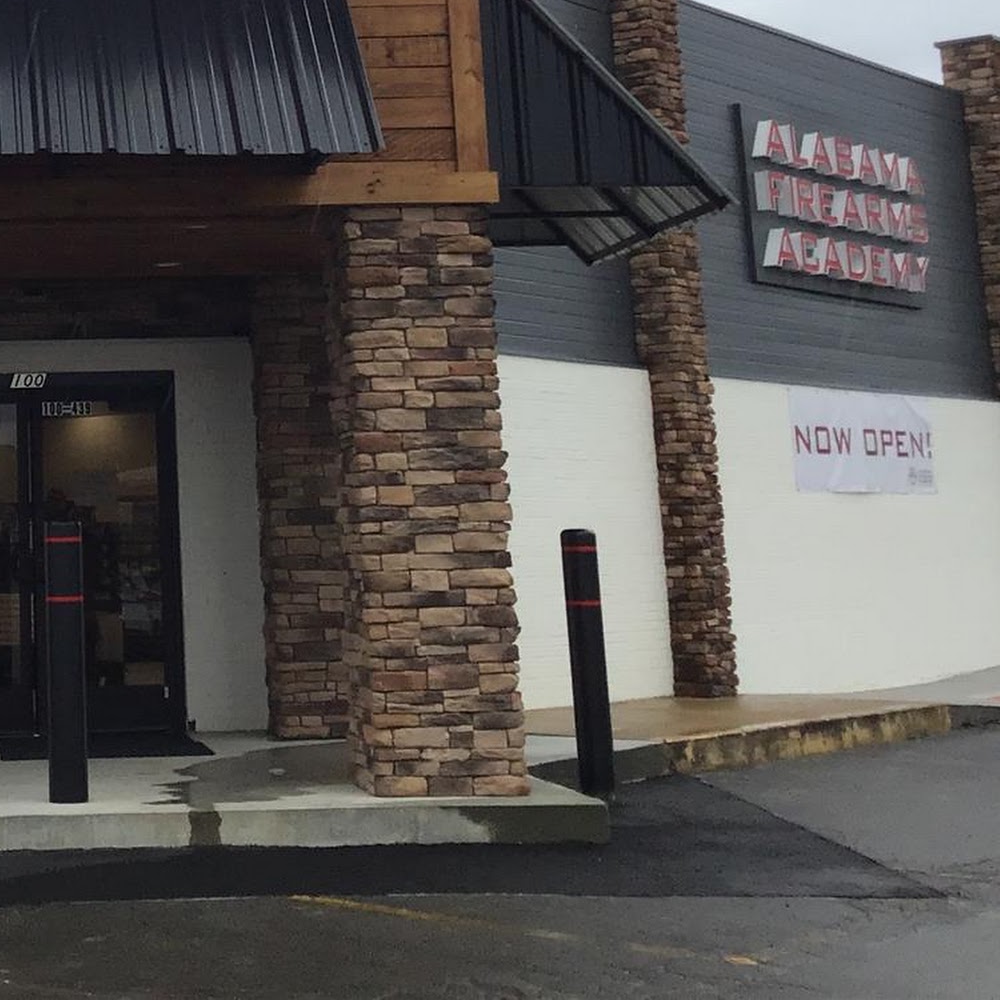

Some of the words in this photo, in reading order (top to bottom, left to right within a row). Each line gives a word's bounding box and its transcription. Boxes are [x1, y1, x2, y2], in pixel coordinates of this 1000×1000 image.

[753, 119, 925, 196] ALABAMA
[755, 169, 929, 243] FIREARMS
[763, 227, 929, 293] ACADEMY
[14, 373, 44, 388] 100
[794, 425, 851, 455] NOW
[863, 428, 932, 459] OPEN!
